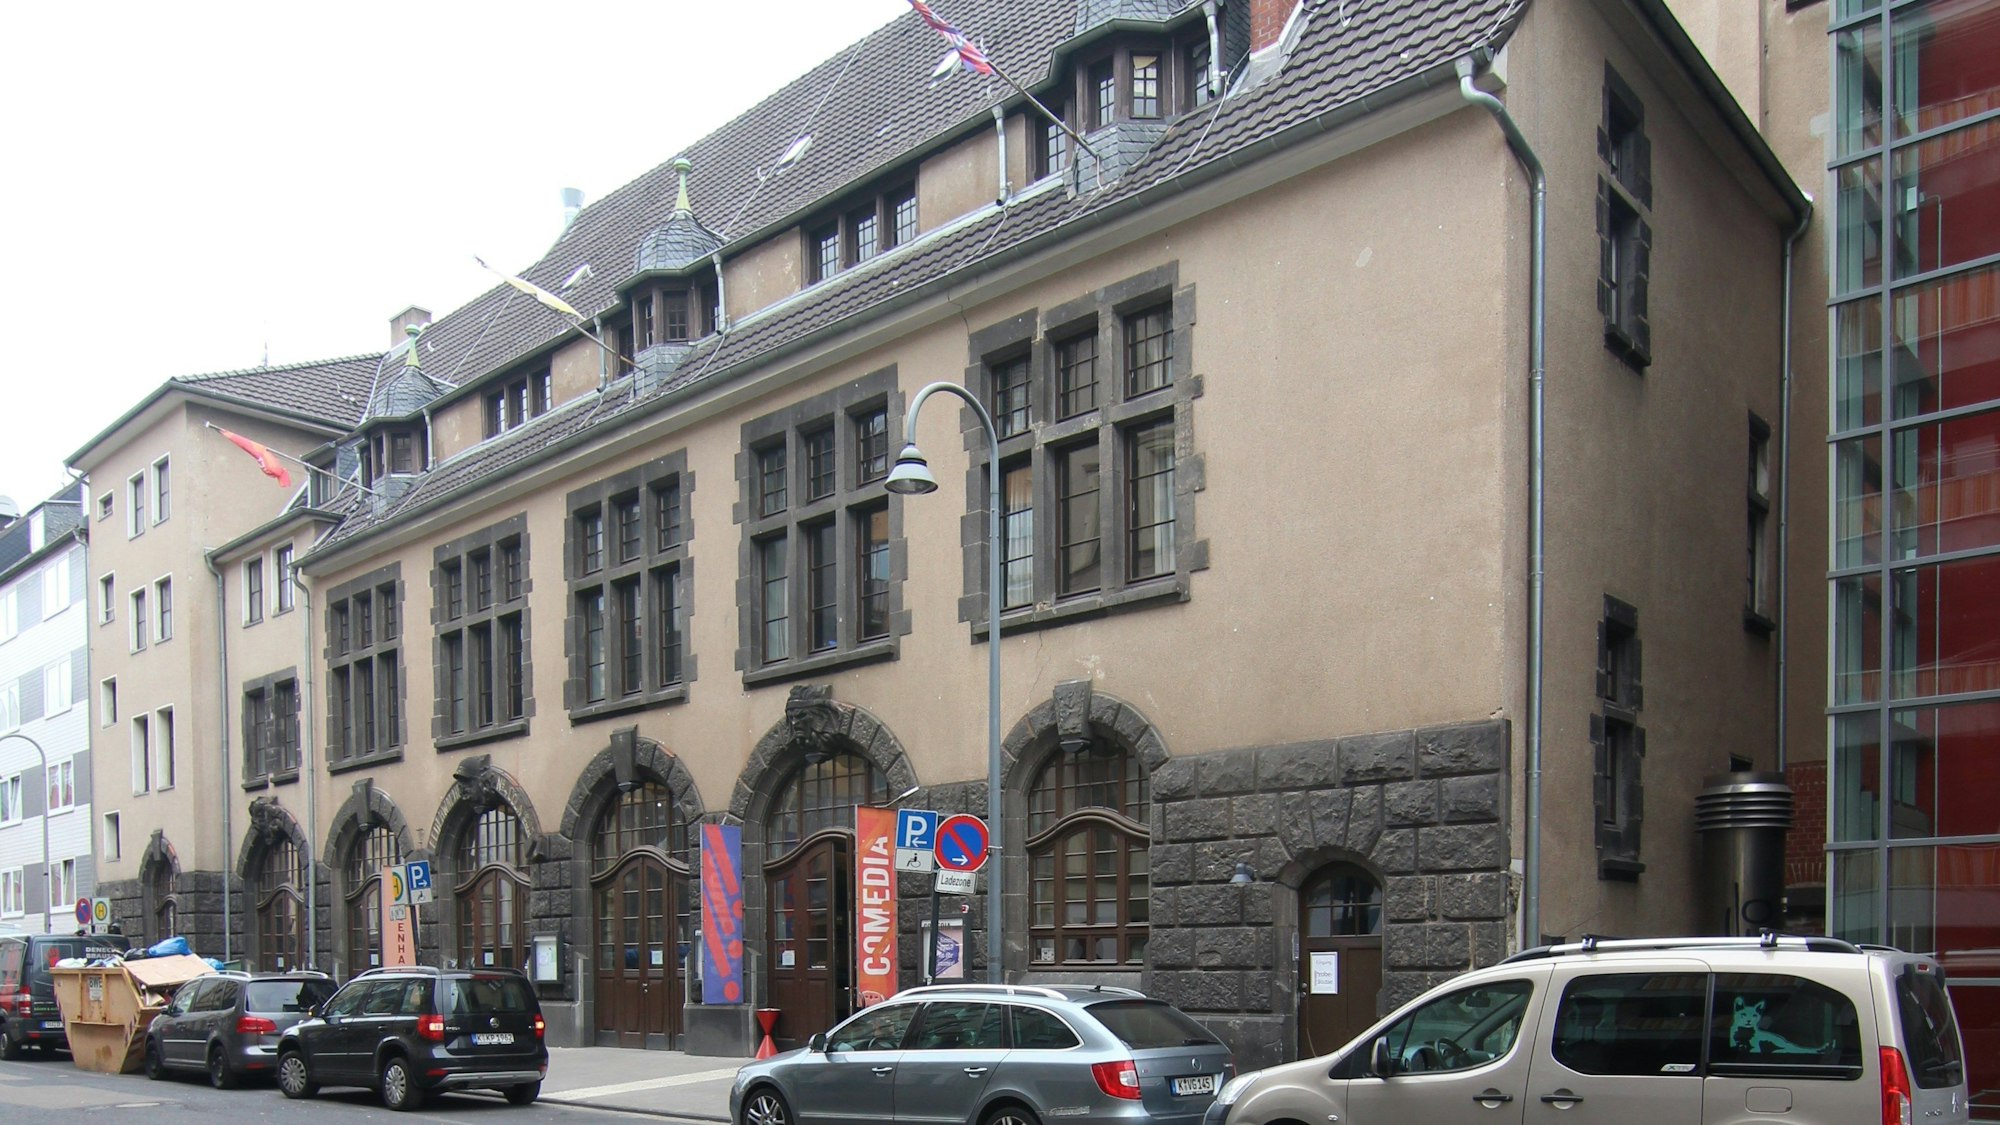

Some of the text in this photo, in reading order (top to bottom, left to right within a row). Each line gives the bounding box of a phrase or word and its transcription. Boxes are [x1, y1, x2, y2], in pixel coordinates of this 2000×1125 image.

[905, 815, 928, 847] P
[411, 865, 423, 888] P
[940, 874, 971, 887] Ladezone
[97, 906, 105, 916] H
[863, 836, 891, 976] COMEDIA
[397, 919, 406, 965] ENHA
